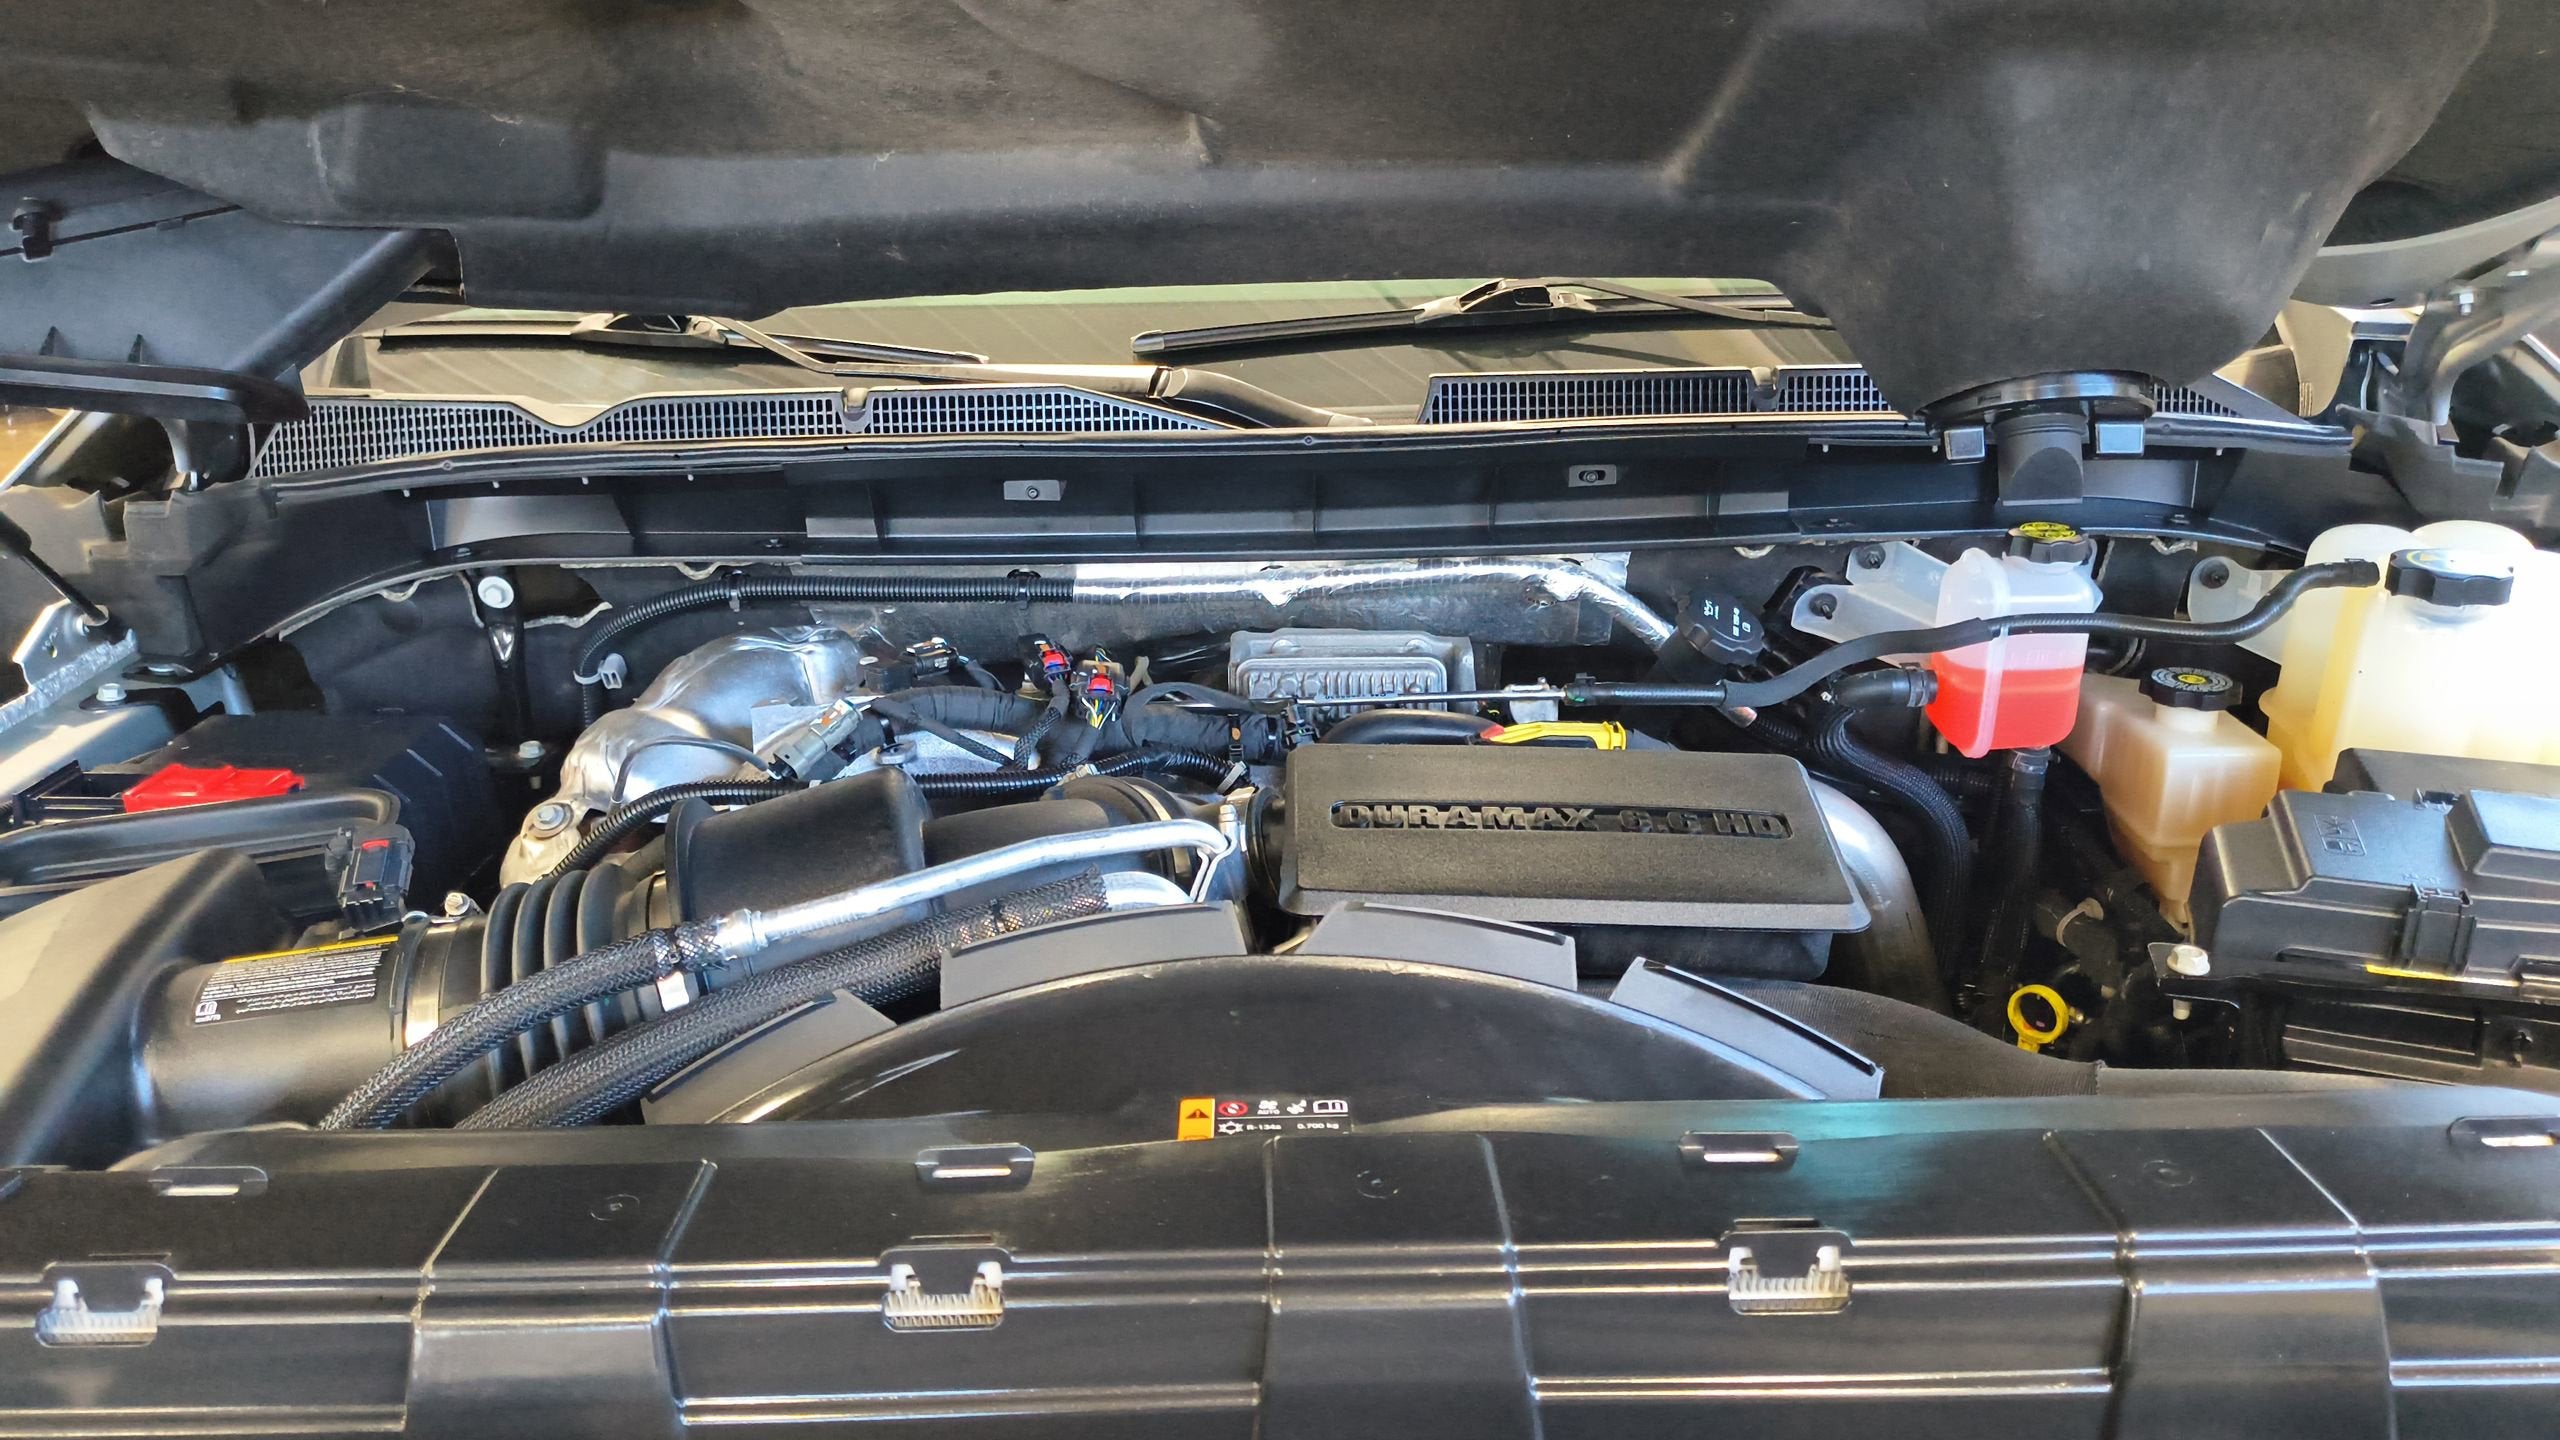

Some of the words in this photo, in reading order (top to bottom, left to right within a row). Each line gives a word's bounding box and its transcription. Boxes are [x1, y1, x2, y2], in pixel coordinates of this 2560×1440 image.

[1338, 805, 1595, 830] DURAMAX
[1711, 812, 1788, 837] HD
[1297, 1122, 1325, 1130] 0.700
[1327, 1122, 1339, 1130] kg
